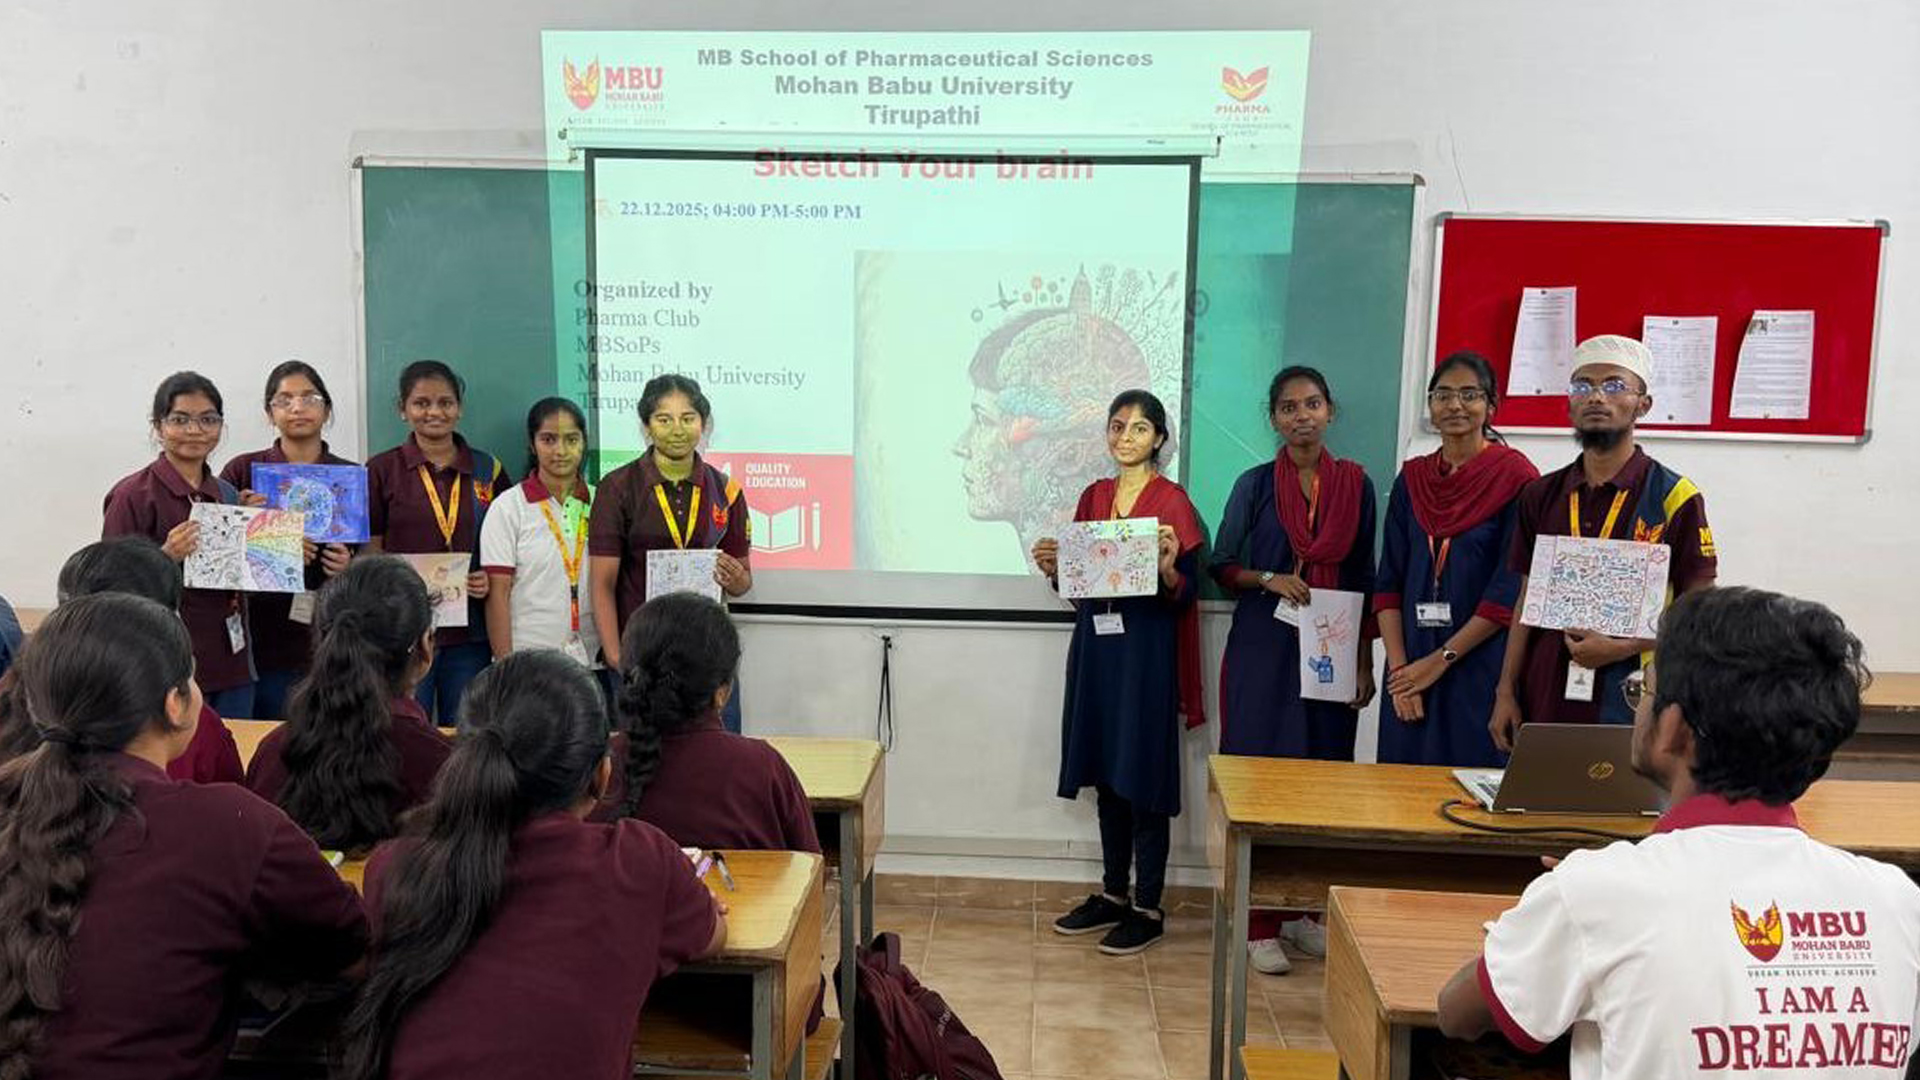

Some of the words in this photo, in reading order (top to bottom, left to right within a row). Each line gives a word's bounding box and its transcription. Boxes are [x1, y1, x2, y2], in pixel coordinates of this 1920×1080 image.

[698, 49, 733, 66] MB
[740, 49, 818, 67] School
[825, 49, 847, 67] of
[855, 49, 1038, 68] Pharmaceutical
[1046, 50, 1153, 68] Sciences
[604, 66, 663, 90] MBU
[775, 75, 859, 95] Mohan
[867, 76, 932, 96] Babu
[941, 76, 1073, 100] University
[864, 104, 980, 129] Tirupathi
[754, 148, 879, 178] Sketch
[897, 149, 976, 179] Your
[996, 149, 1095, 179] brain
[620, 202, 708, 218] 22.12.2025;
[713, 202, 756, 218] 04:00
[760, 203, 828, 219] PM-5:00
[834, 204, 862, 219] PM
[574, 280, 680, 302] Organized
[688, 281, 713, 304] by
[575, 307, 647, 327] Pharma
[653, 308, 700, 327] Club
[576, 335, 661, 355] MBSoPs
[577, 363, 643, 383] Mohan
[705, 365, 806, 390] University
[745, 463, 791, 475] QUALITY
[745, 477, 806, 489] EDUCATION
[1786, 911, 1867, 938] MBU
[1791, 940, 1837, 951] MOHAN
[1839, 940, 1871, 951] BABU
[1792, 951, 1873, 961] UNIVERSITY
[1755, 986, 1772, 1014] I
[1781, 986, 1837, 1013] AM
[1847, 986, 1870, 1013] A
